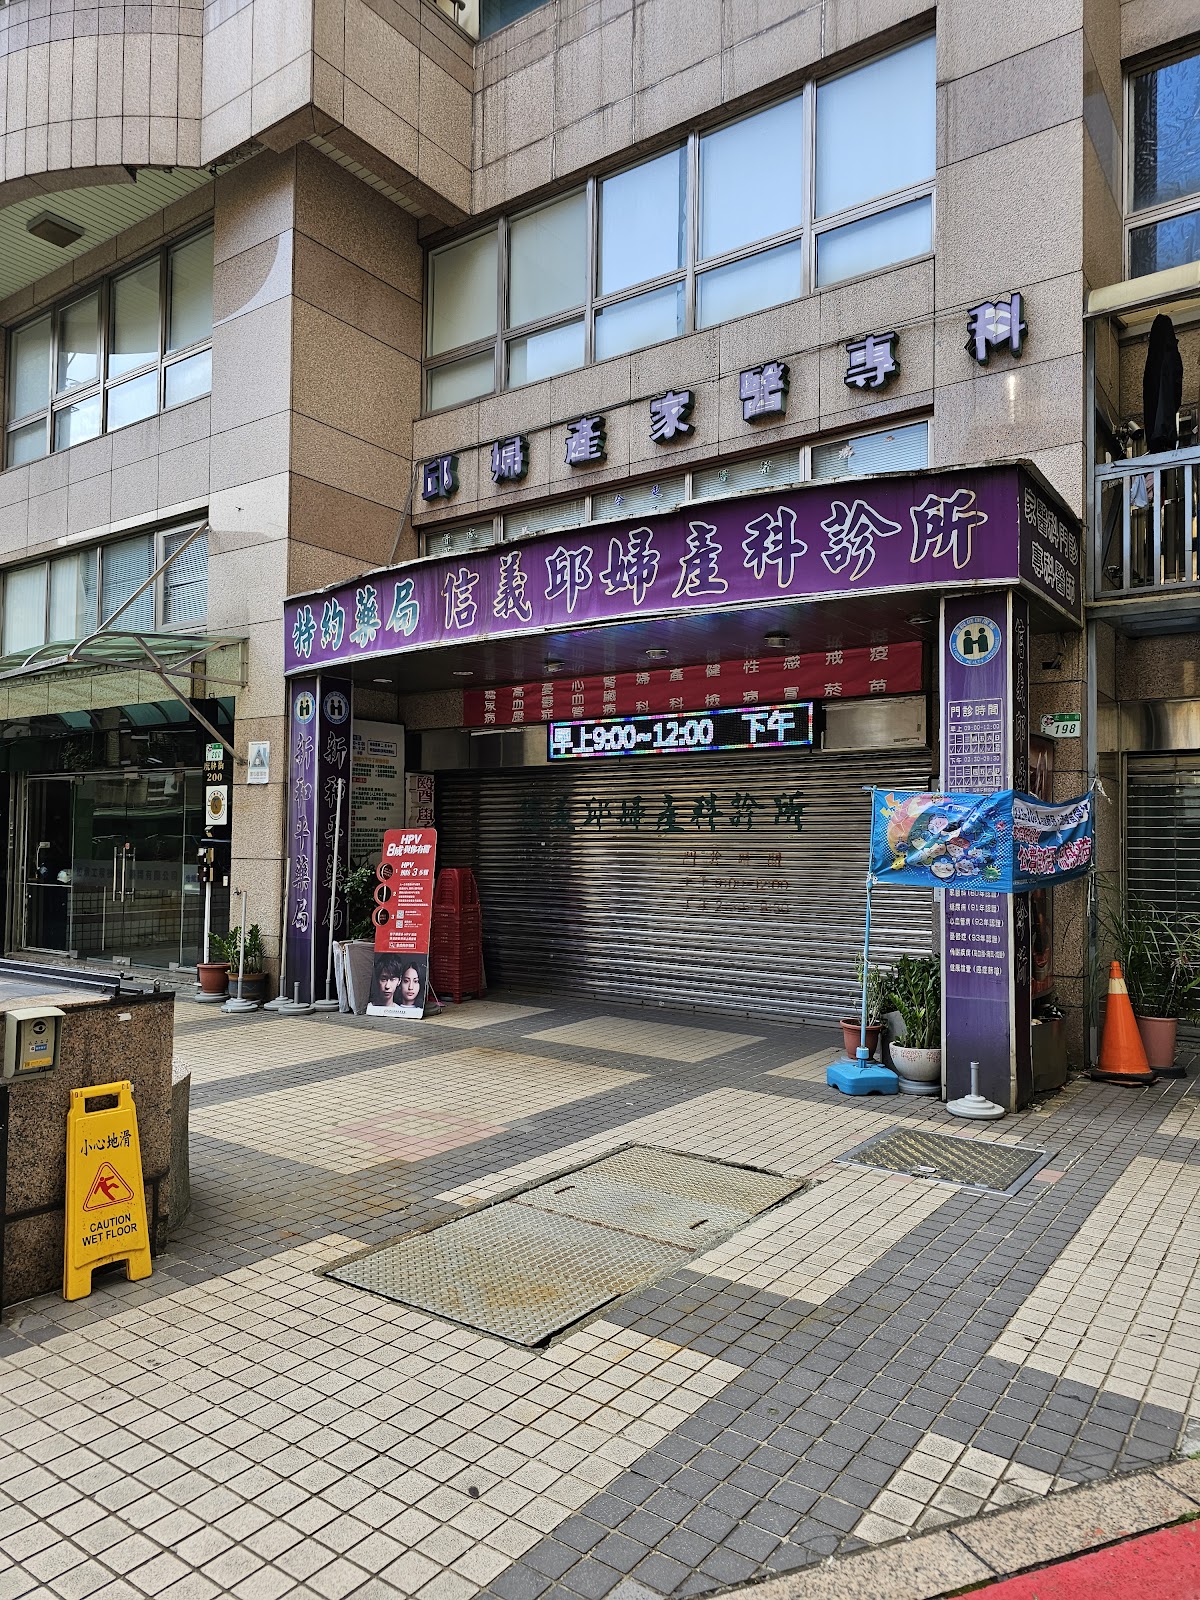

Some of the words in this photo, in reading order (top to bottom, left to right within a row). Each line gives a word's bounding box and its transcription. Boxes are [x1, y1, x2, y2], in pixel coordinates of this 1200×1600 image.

[1024, 487, 1078, 566] 家醫科門診
[440, 488, 988, 630] 信義邱婦產科診所
[1031, 540, 1076, 605] 專科醫師
[669, 668, 684, 710] 產科
[704, 663, 721, 707] 健檢
[742, 660, 760, 704] 性病
[783, 655, 801, 701] 感冒
[824, 650, 844, 697] 戒菸
[869, 646, 889, 693] 疫苗
[484, 690, 497, 724] 糖尿病
[512, 686, 525, 723] 高血壓
[571, 680, 585, 719] 心血管
[635, 672, 651, 713] 婦科
[950, 703, 999, 718] 門診時間
[552, 718, 714, 754] 早上9:00~12:00
[741, 710, 796, 743] 下午
[1054, 723, 1076, 735] 198
[206, 772, 223, 782] 200
[291, 732, 314, 933] 新和平藥局
[400, 833, 422, 845] HPV
[400, 861, 414, 869] HPV
[411, 867, 418, 877] 3
[80, 1129, 132, 1157] 小心地滑
[82, 1230, 105, 1248] WET
[106, 1222, 138, 1241] FLOOR
[89, 1213, 132, 1233] CAUTION
